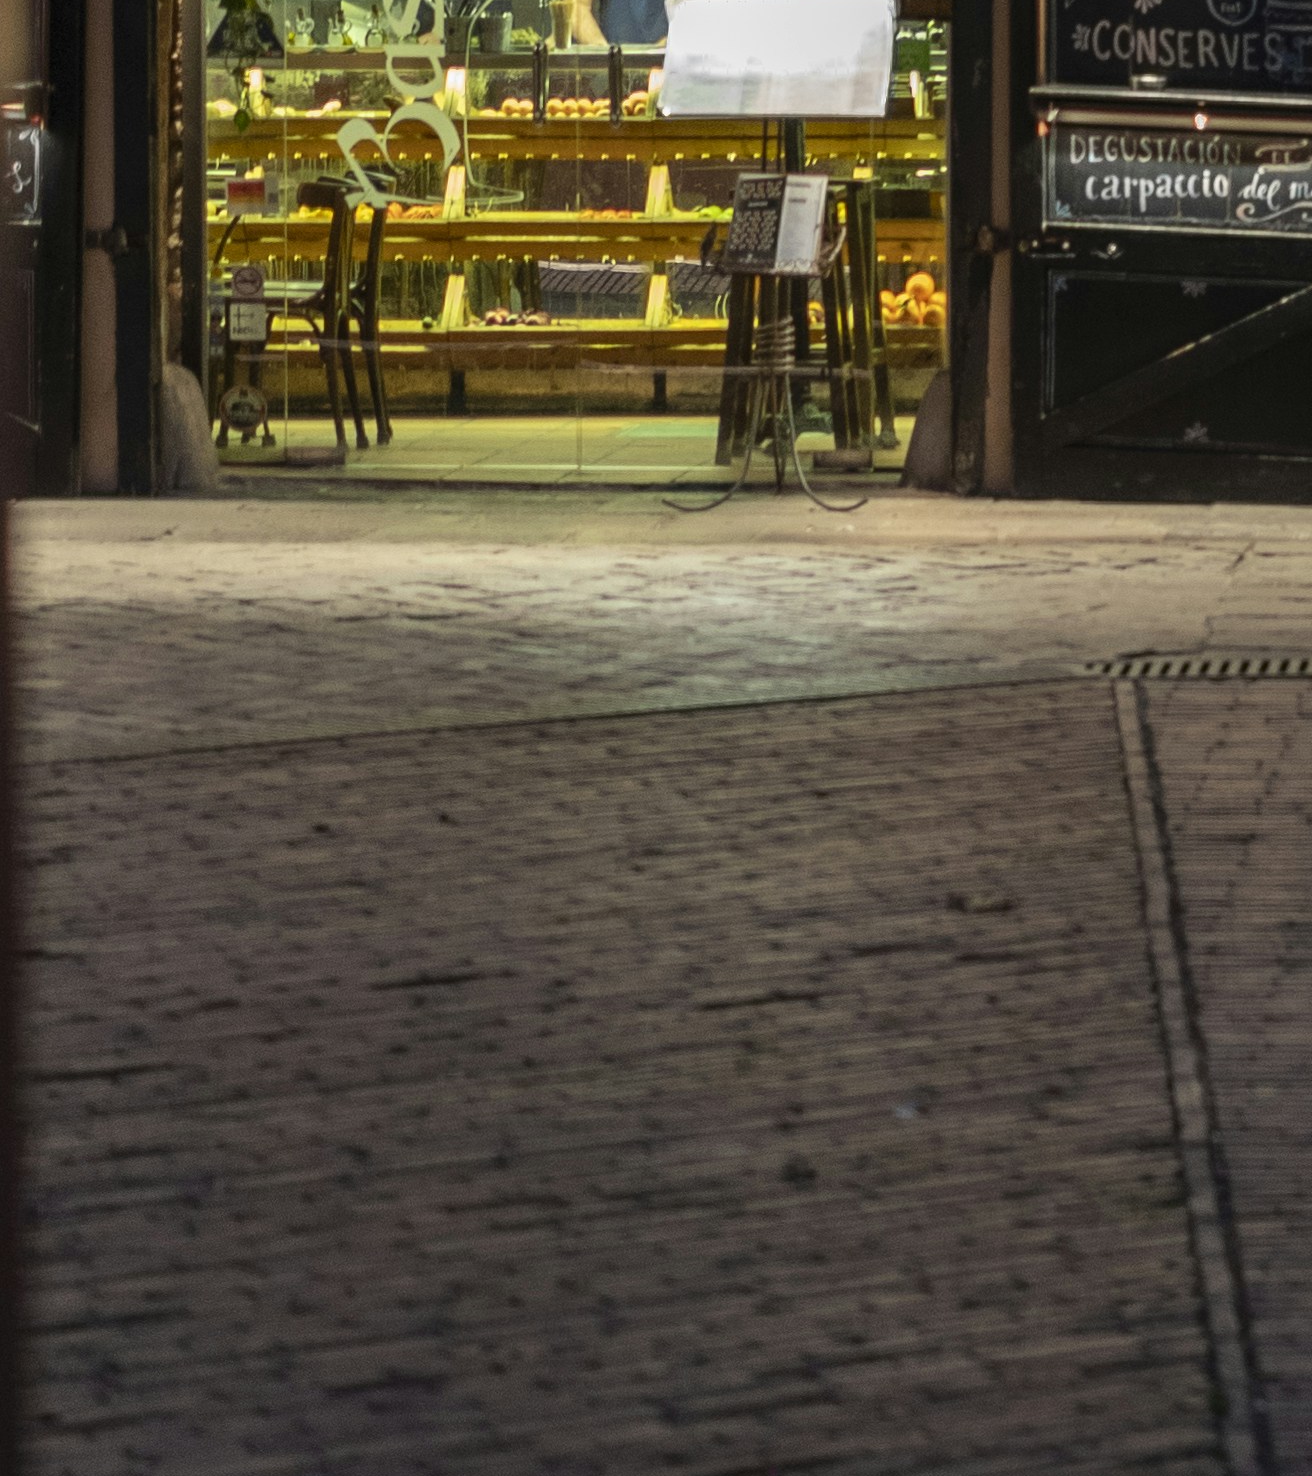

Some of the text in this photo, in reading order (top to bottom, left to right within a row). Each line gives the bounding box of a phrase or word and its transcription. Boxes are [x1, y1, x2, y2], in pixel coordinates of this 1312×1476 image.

[1092, 19, 1283, 72] CONSERVES
[1069, 133, 1241, 166] DEGUSTACIÓN
[1085, 169, 1229, 213] carpaccio
[1238, 166, 1281, 211] del
